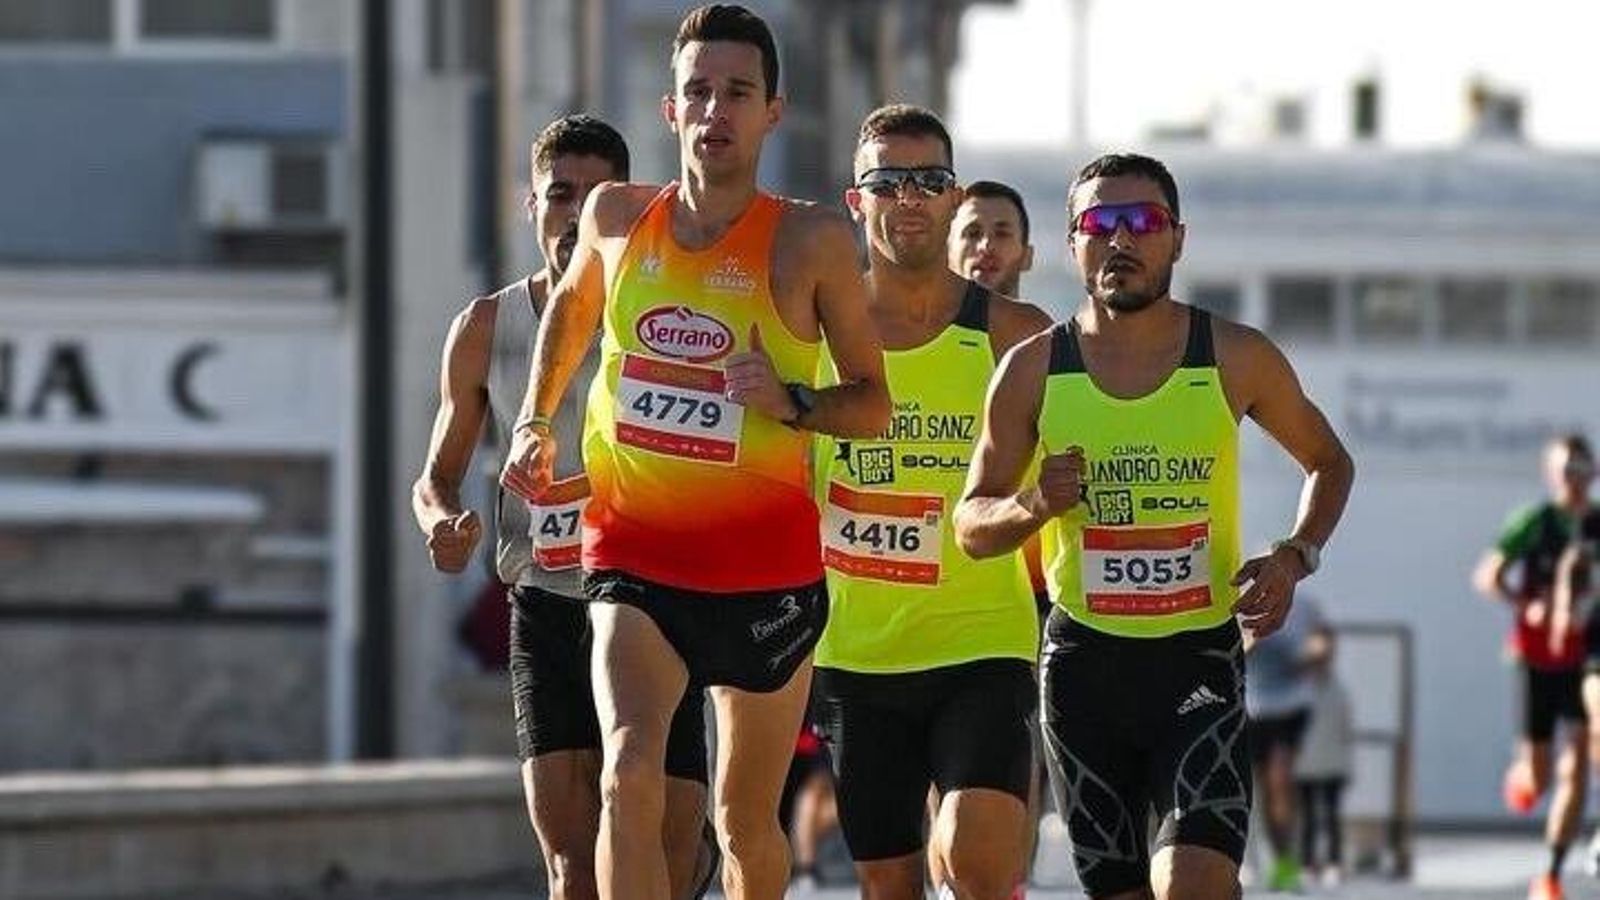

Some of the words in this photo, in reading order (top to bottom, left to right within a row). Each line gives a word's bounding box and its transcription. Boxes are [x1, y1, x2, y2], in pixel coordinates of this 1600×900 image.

[646, 319, 726, 350] Serrano
[632, 390, 722, 428] 4779
[927, 414, 975, 440] SANZ
[900, 454, 970, 468] SOUL
[1166, 456, 1215, 481] SANZ
[1141, 496, 1209, 510] SOUL
[541, 510, 580, 537] 47
[840, 520, 921, 551] 4416
[1103, 554, 1192, 585] 5053
